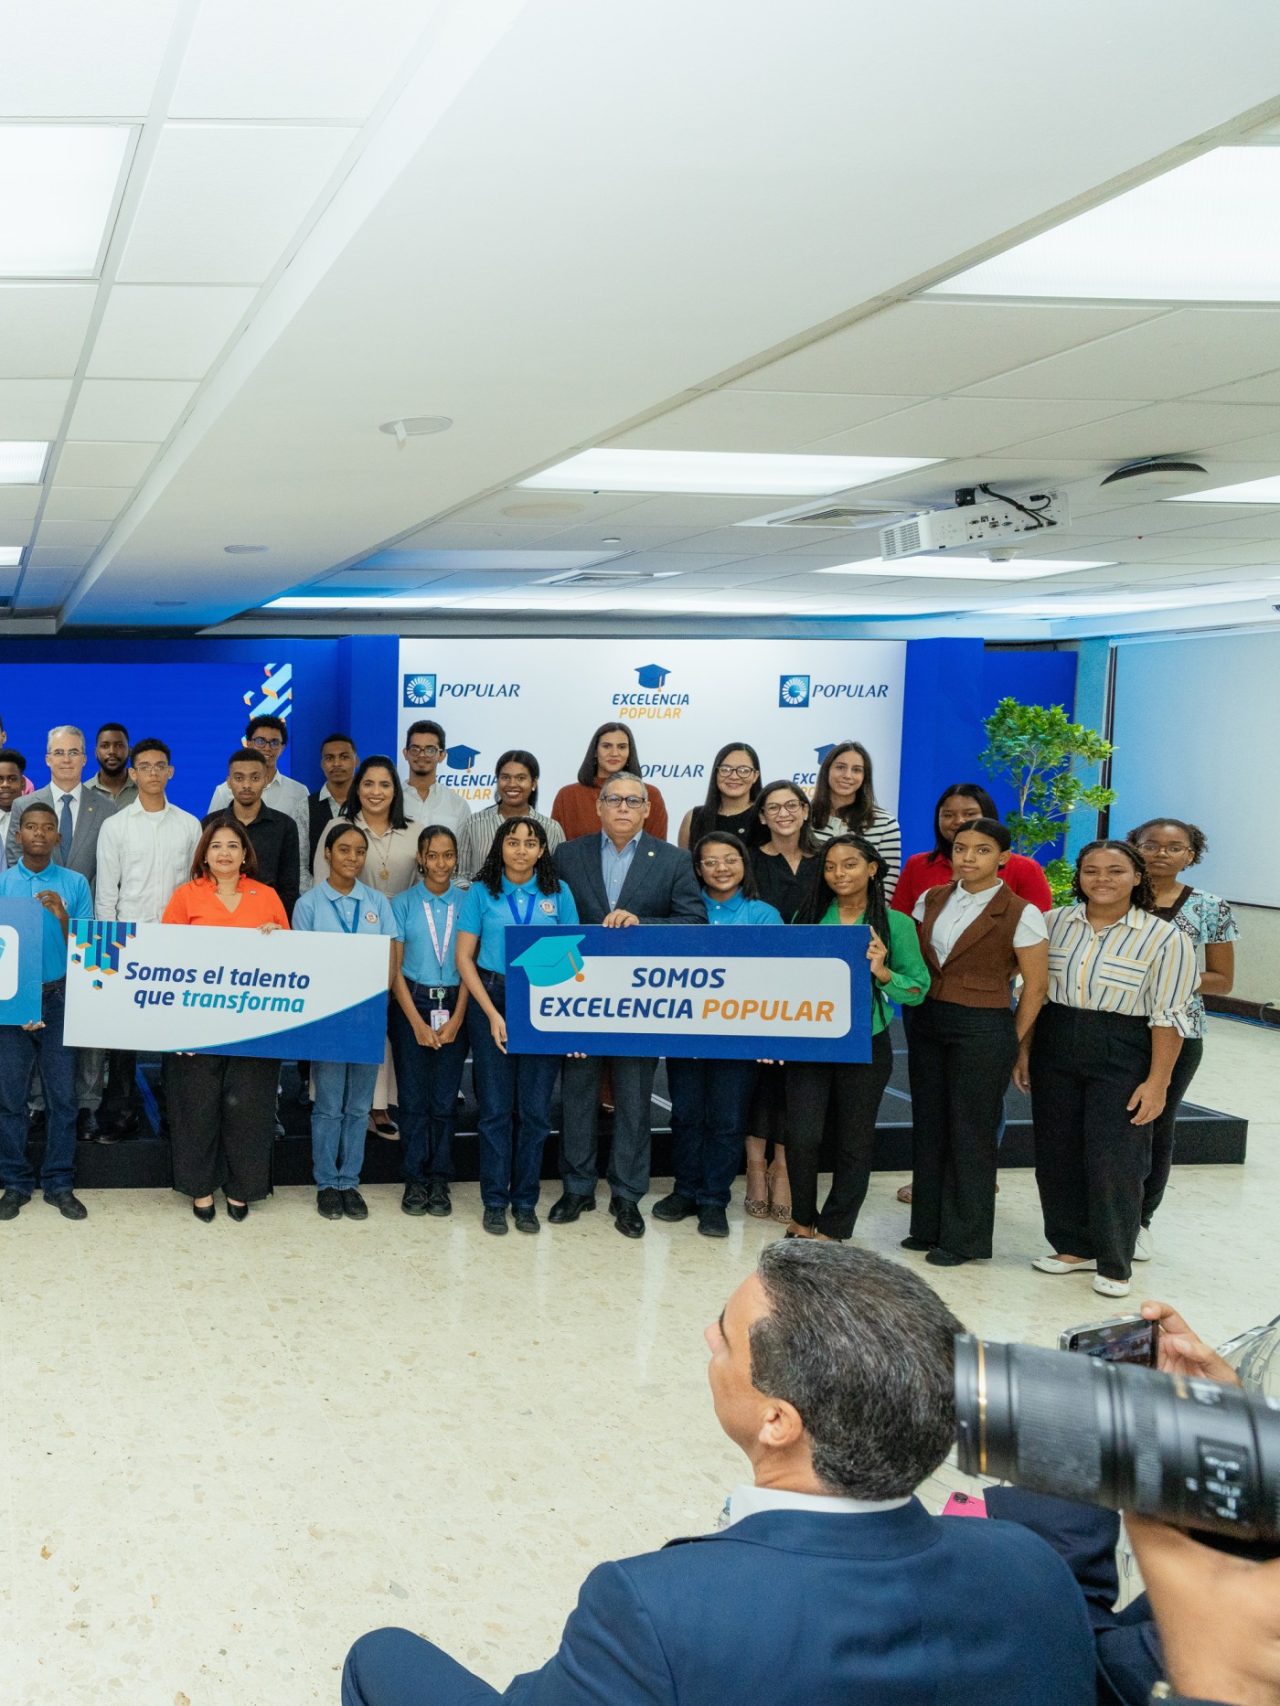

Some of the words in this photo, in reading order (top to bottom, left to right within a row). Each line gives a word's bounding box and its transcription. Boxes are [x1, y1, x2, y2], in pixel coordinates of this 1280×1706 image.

[439, 683, 521, 698] POPULAR
[812, 684, 889, 698] POPULAR
[611, 693, 690, 706] EXCELENCIA
[619, 707, 682, 719] POPULAR
[640, 764, 705, 778] OPULAR
[124, 961, 198, 984] Somos
[202, 965, 224, 985] el
[229, 967, 311, 990] talento
[631, 967, 726, 989] SOMOS
[133, 989, 175, 1009] que
[181, 989, 305, 1014] transforma
[539, 996, 693, 1020] EXCELENCIA
[701, 998, 835, 1023] POPULAR
